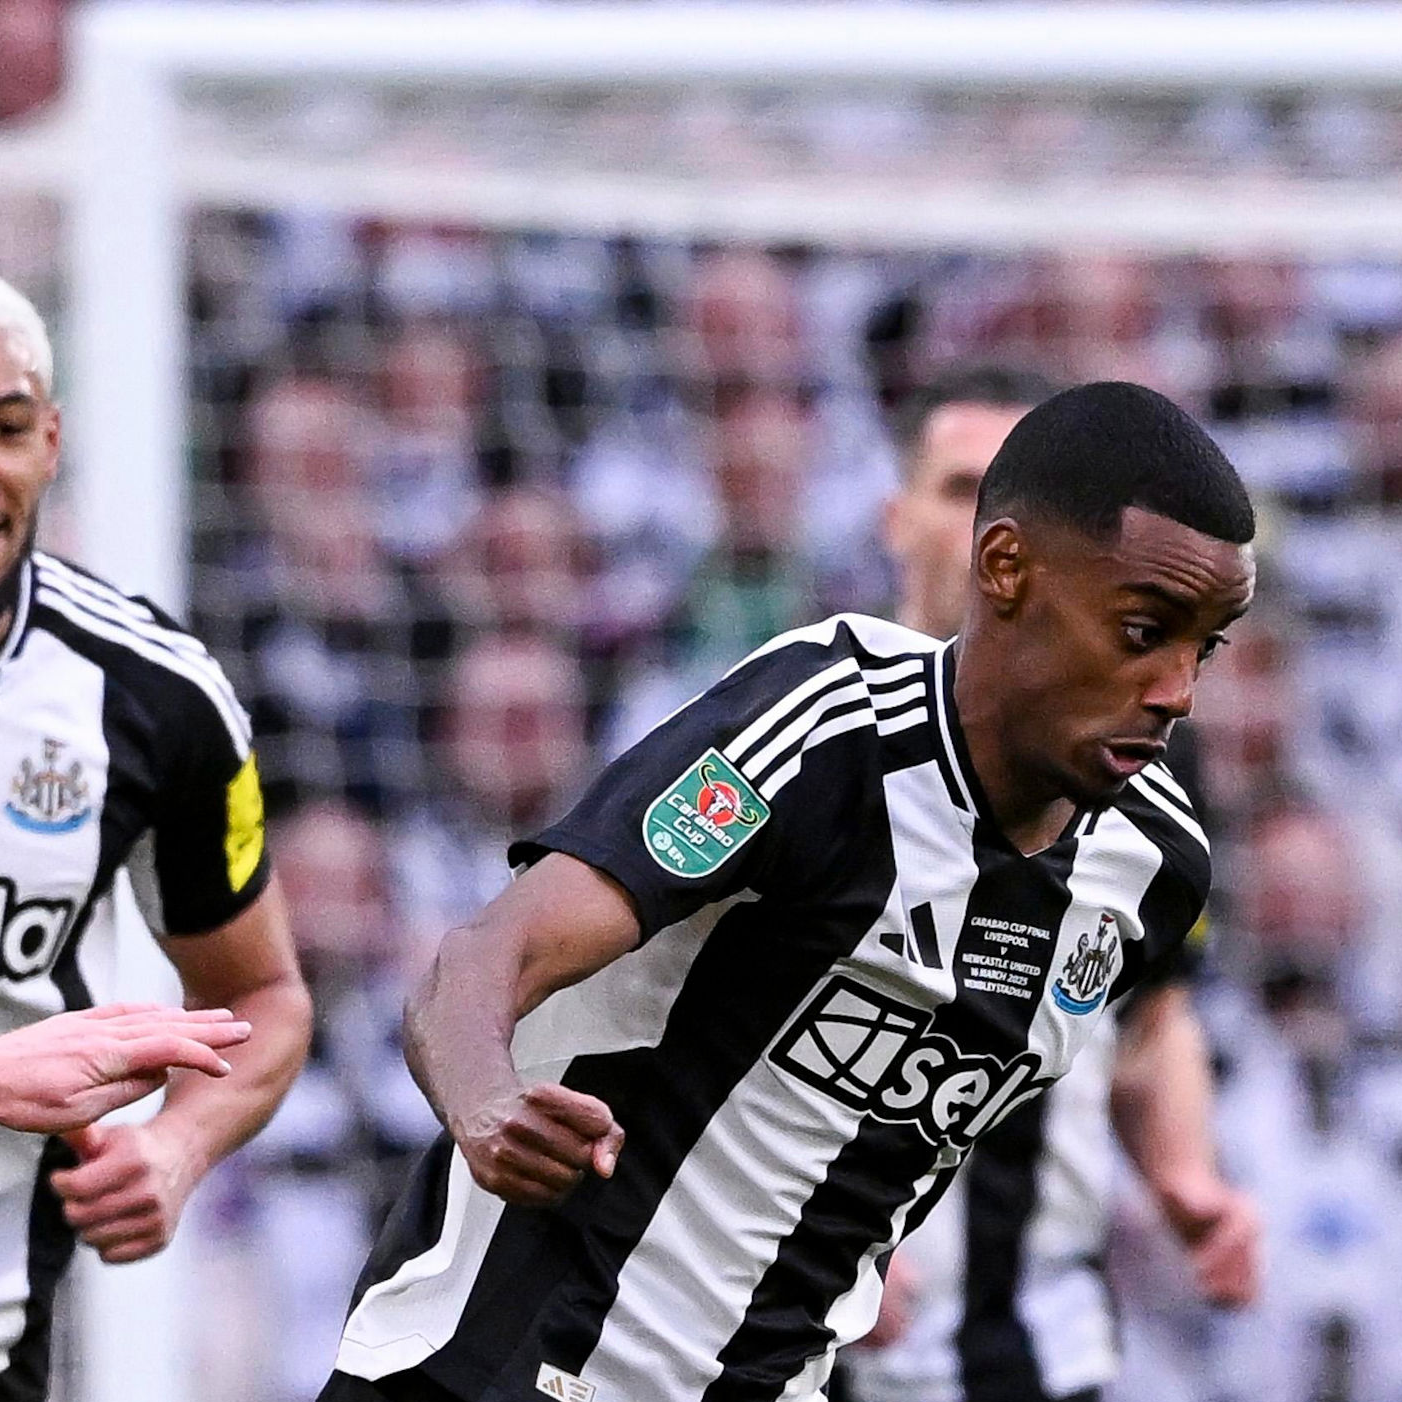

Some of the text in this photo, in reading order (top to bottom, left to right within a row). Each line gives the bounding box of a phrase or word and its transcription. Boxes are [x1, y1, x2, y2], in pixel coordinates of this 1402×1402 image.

[667, 793, 734, 848] Carabao
[673, 815, 706, 846] Cup
[971, 916, 1051, 940] CARABAO CUP FINAL
[984, 930, 1029, 948] LIVERPOOL
[962, 953, 1041, 976] NEWCASTLE UNITED
[881, 1047, 1043, 1138] sel
